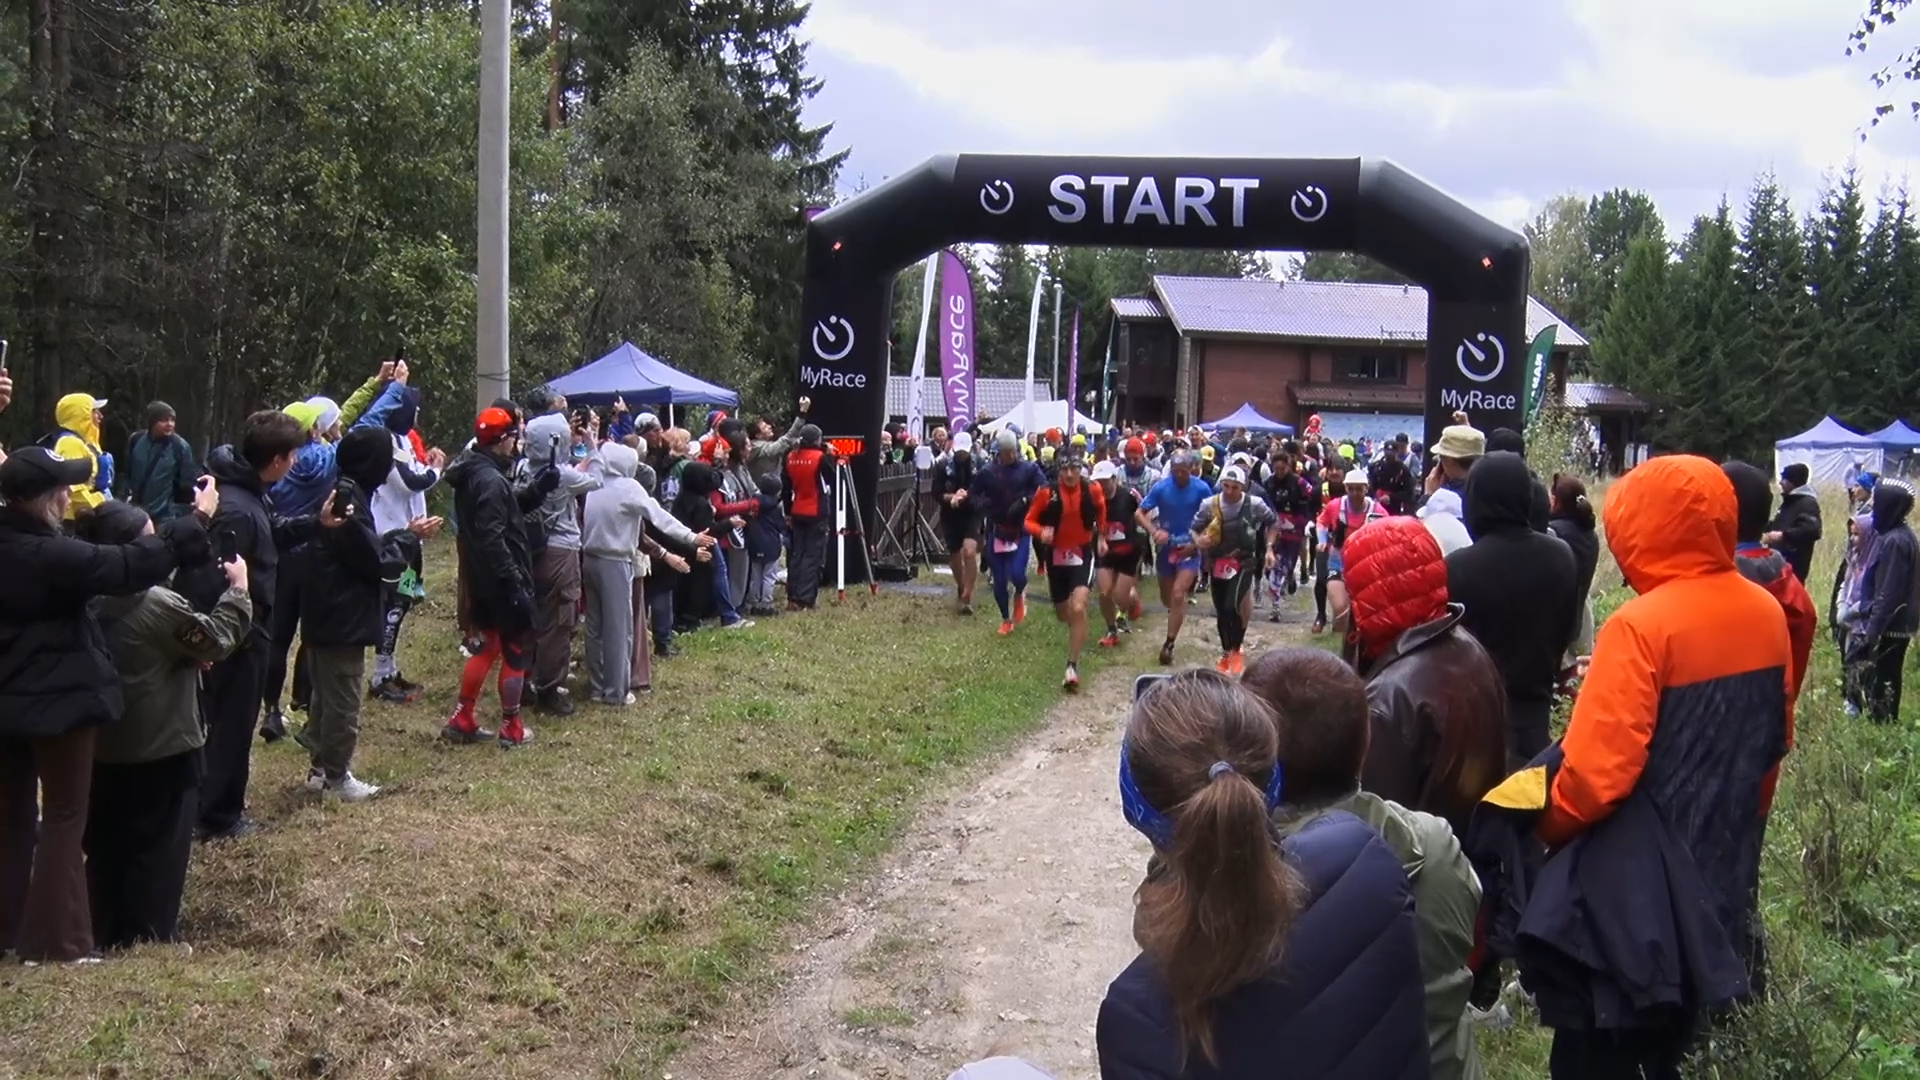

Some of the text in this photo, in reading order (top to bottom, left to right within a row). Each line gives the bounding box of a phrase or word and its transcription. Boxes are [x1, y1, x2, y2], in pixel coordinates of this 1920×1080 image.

[1047, 174, 1260, 227] START
[800, 365, 867, 389] MyRace
[1440, 388, 1517, 411] MyRace
